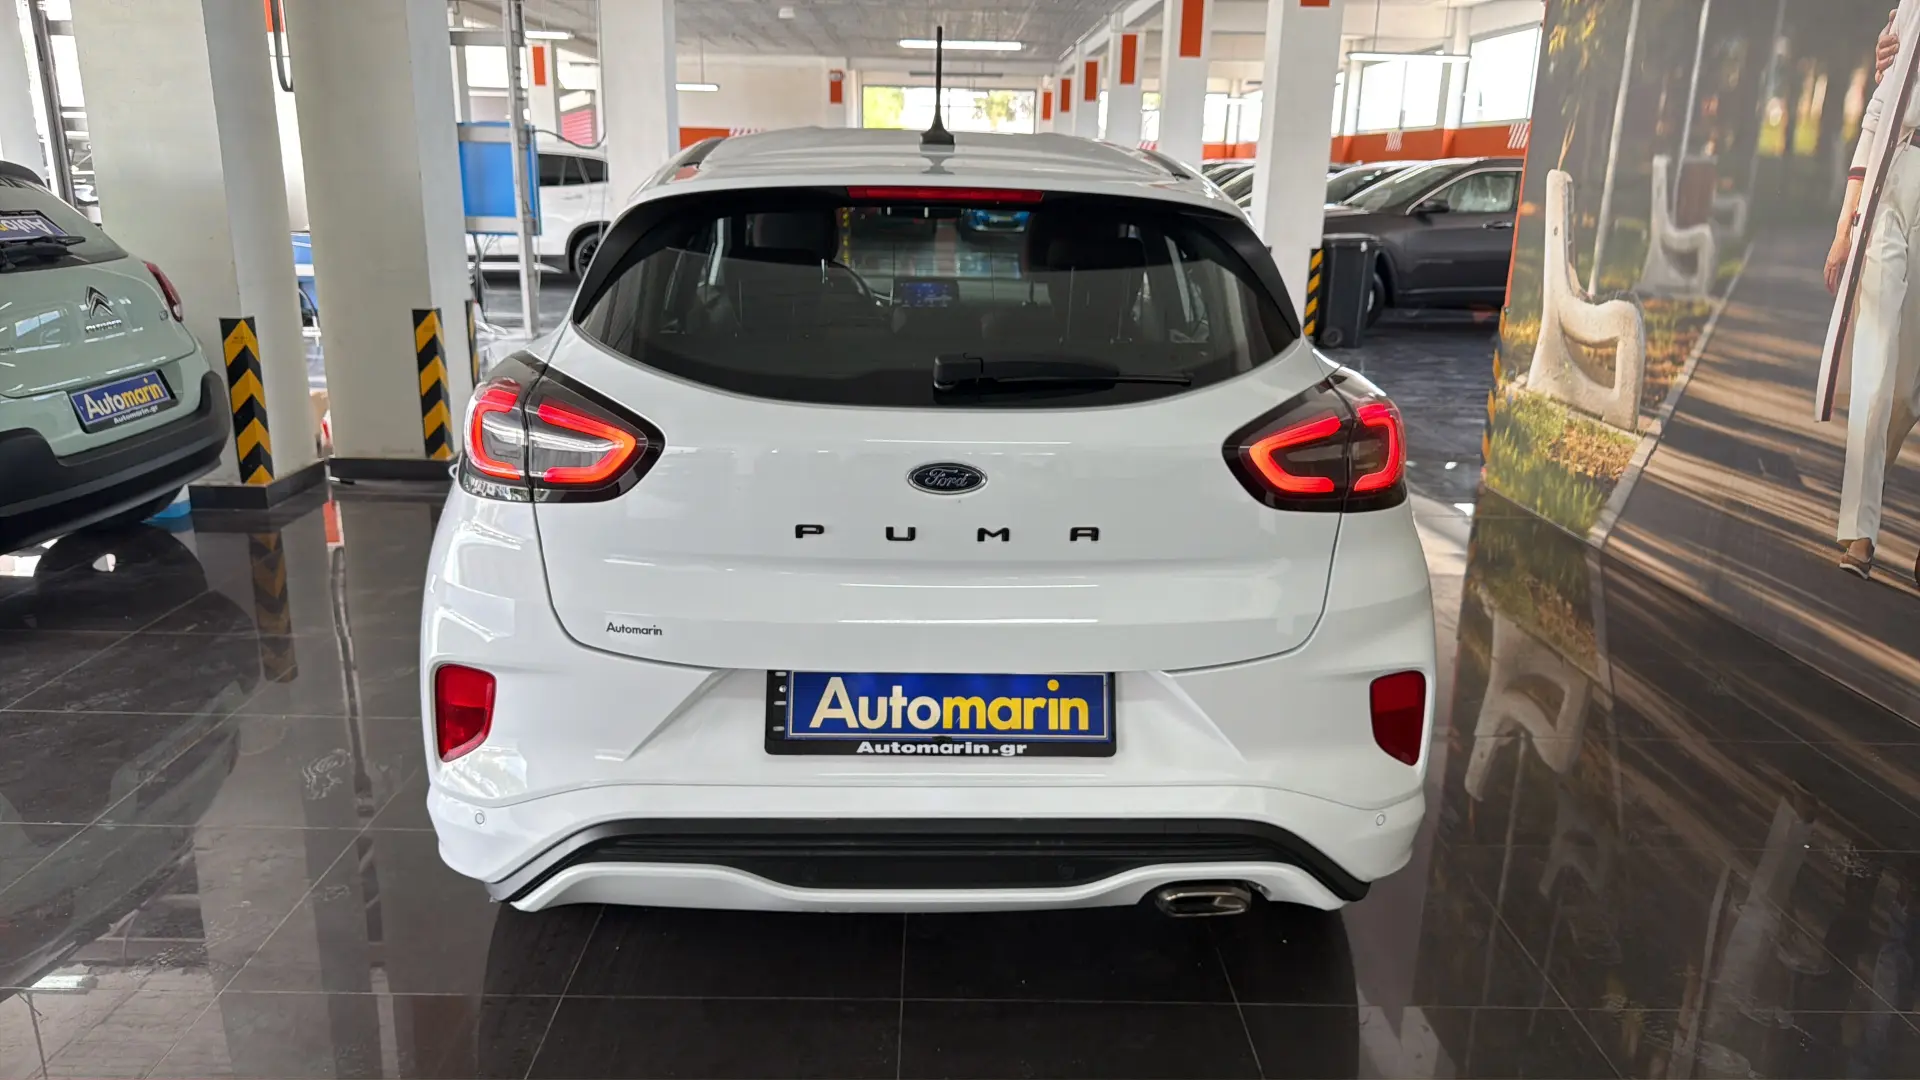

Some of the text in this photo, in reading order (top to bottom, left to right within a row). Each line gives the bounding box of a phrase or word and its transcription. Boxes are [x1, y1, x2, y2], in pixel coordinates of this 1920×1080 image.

[83, 378, 164, 420] Automarin
[113, 405, 159, 424] Automarin.gr
[925, 468, 969, 487] Ford
[795, 524, 1099, 542] PUMA
[606, 621, 663, 636] Automarin
[809, 677, 1089, 730] Automarin
[856, 741, 1027, 757] Automarin.gr
